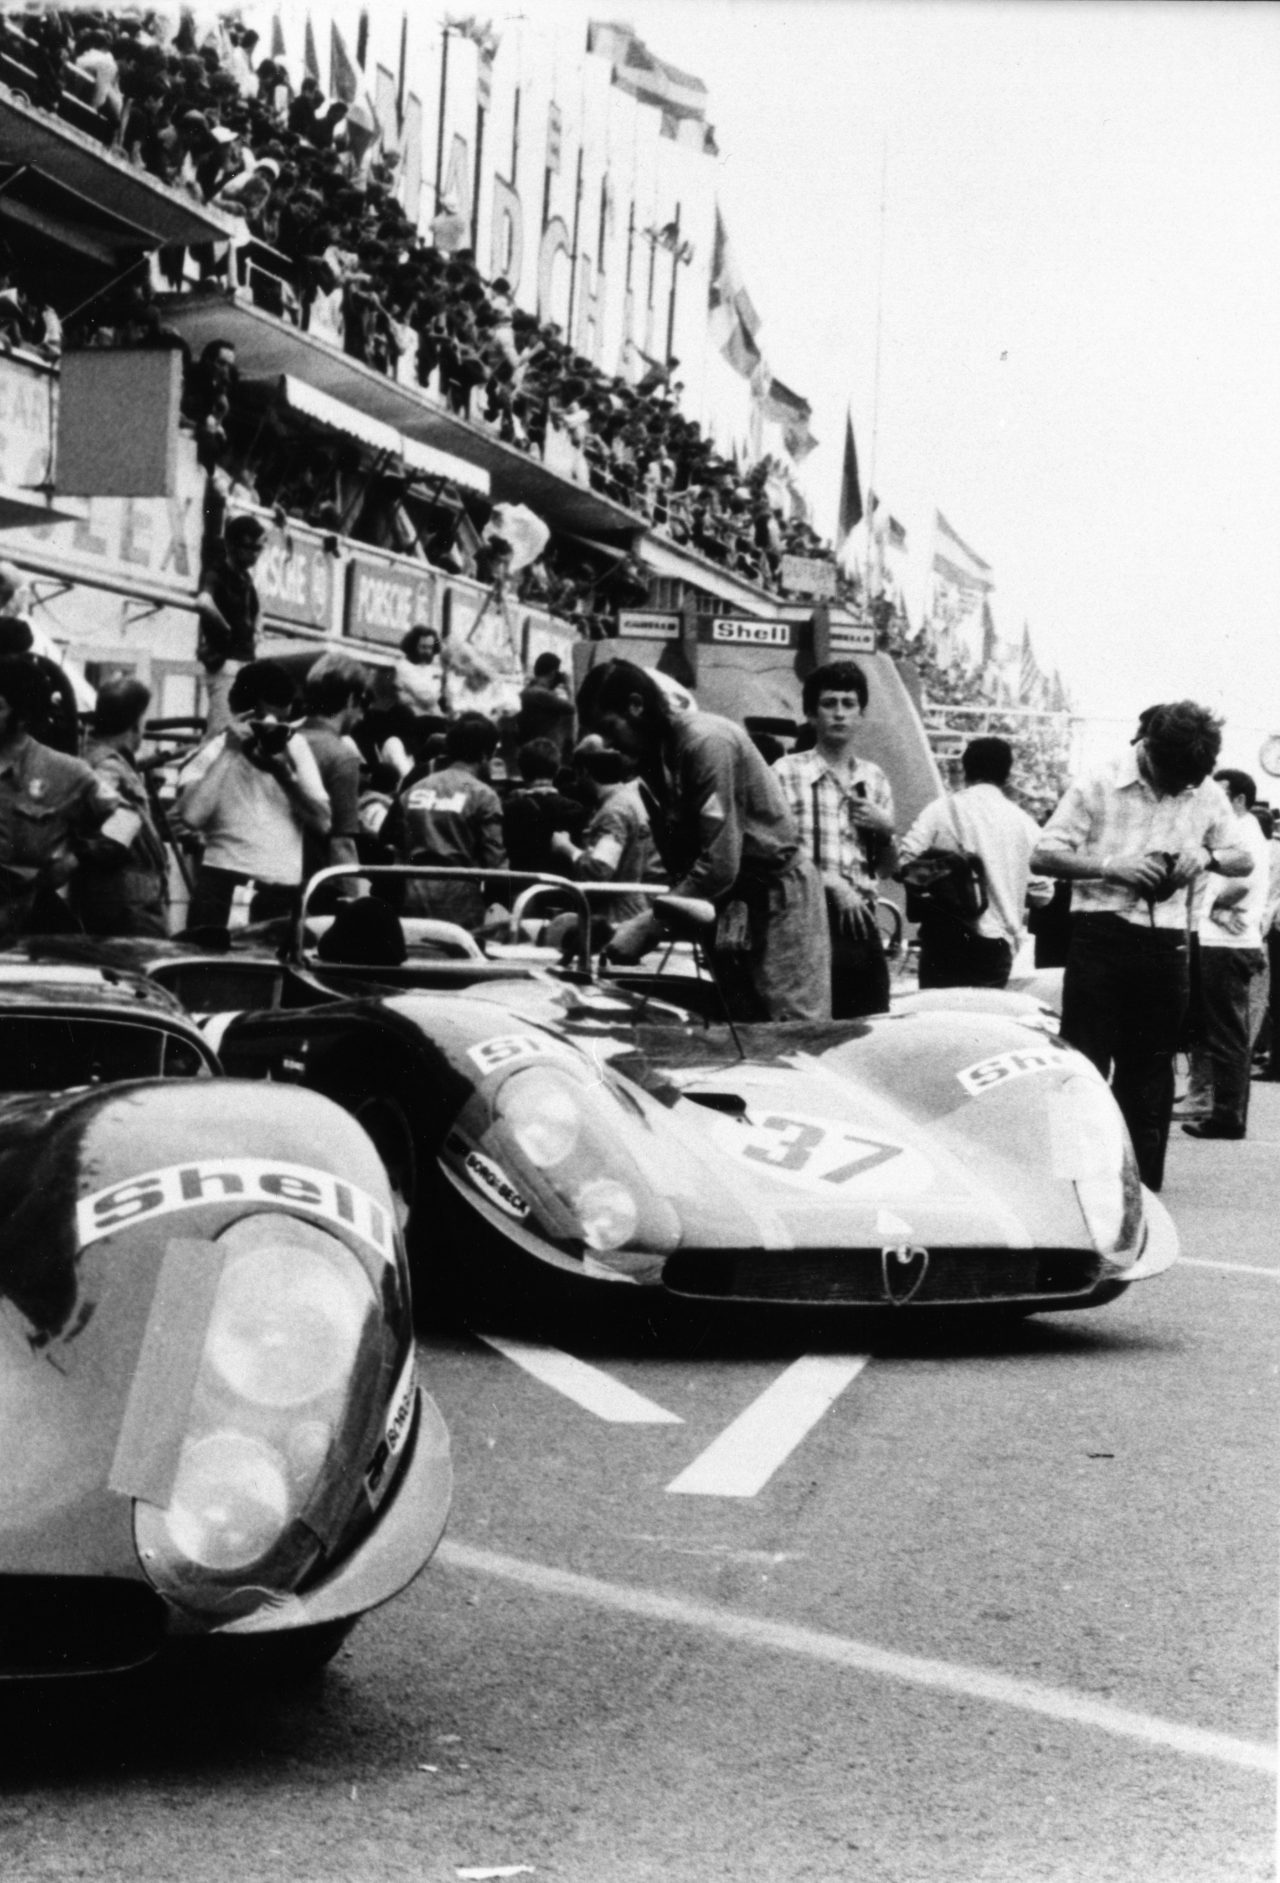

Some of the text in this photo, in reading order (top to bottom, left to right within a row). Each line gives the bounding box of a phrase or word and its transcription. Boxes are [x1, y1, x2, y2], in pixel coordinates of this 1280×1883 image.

[717, 623, 787, 643] Shell
[742, 1114, 904, 1184] 37
[93, 1168, 388, 1255] Shell
